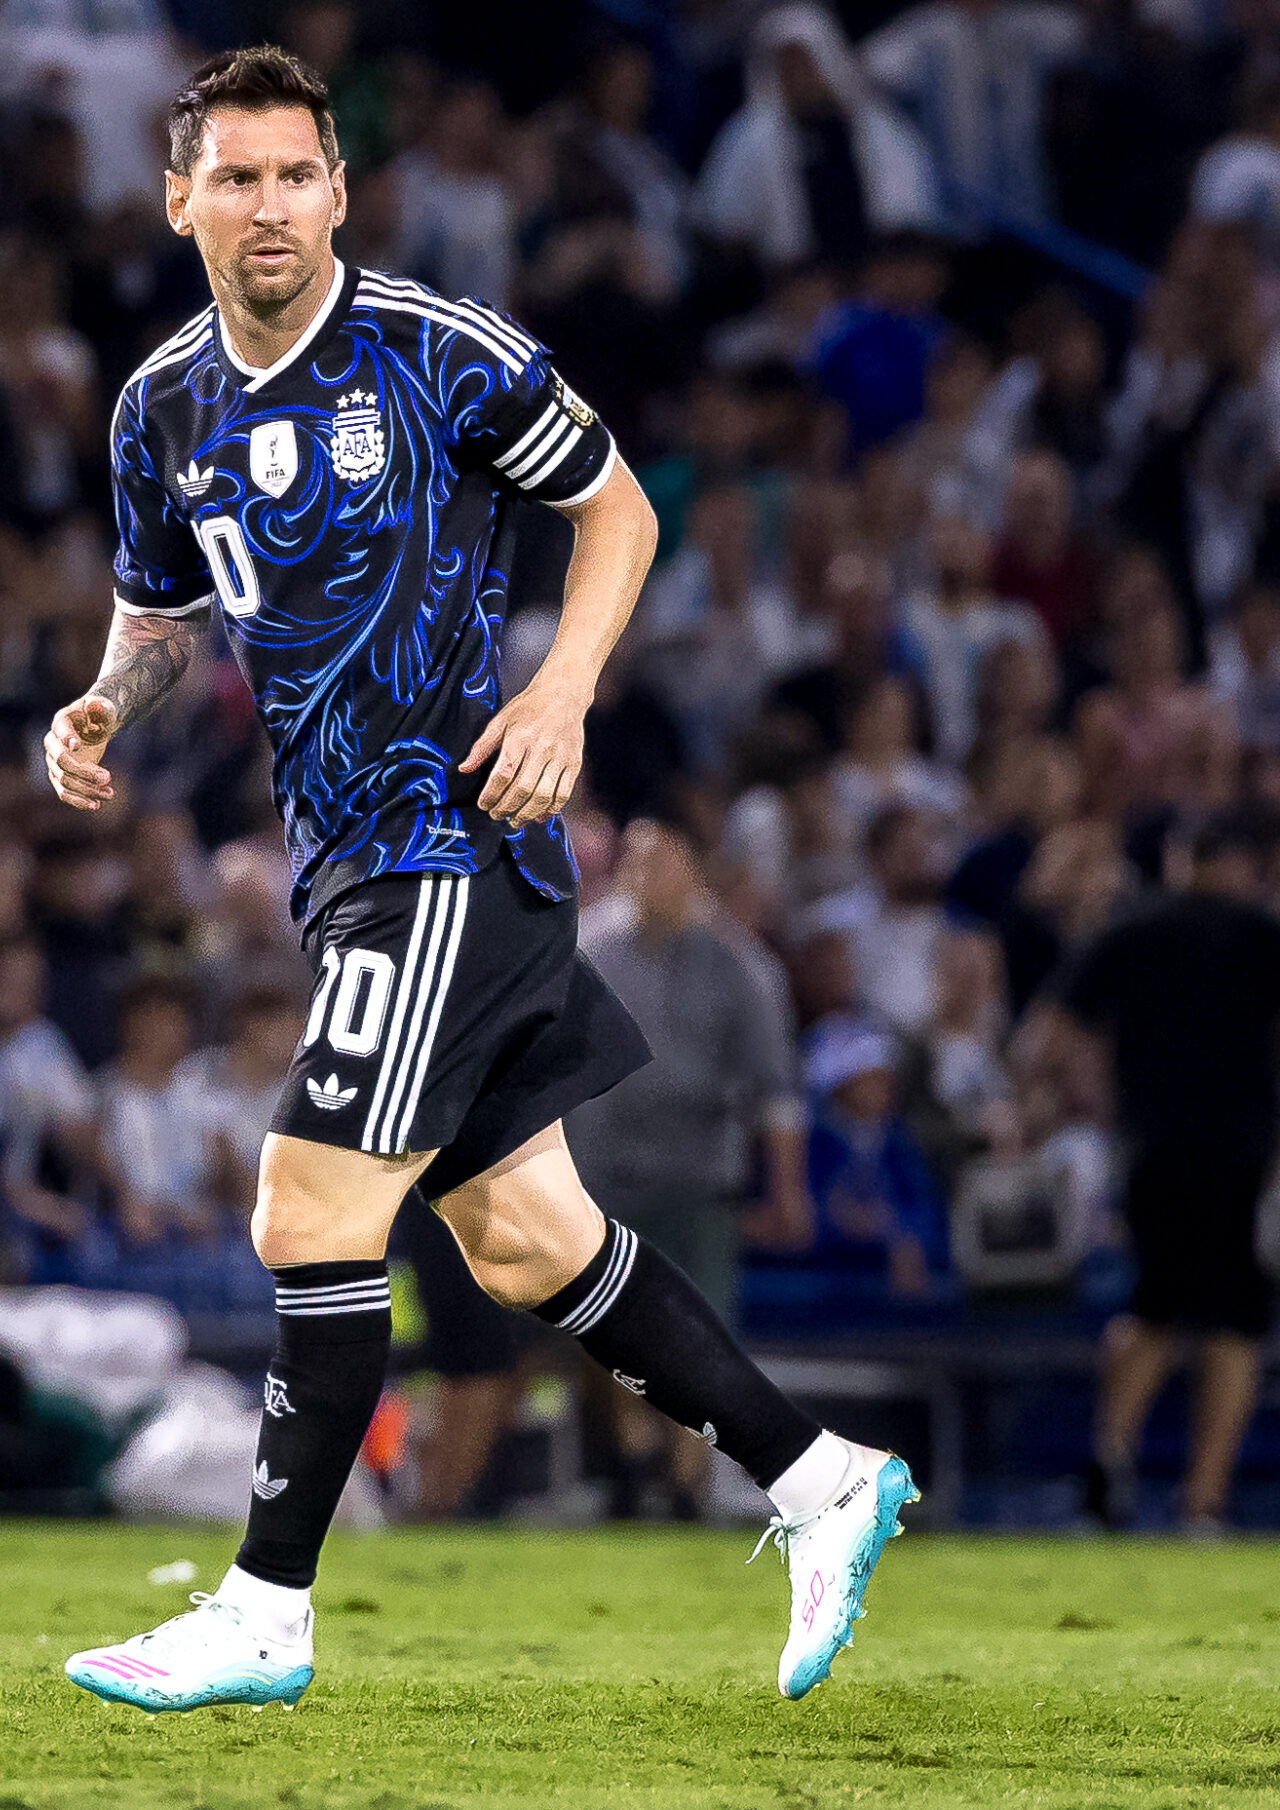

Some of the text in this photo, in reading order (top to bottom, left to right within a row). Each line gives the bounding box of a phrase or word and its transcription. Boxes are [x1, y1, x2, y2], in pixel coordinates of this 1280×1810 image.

[266, 469, 285, 479] FIFA
[343, 428, 372, 459] AFA
[190, 515, 261, 619] 0
[303, 945, 396, 1058] 10
